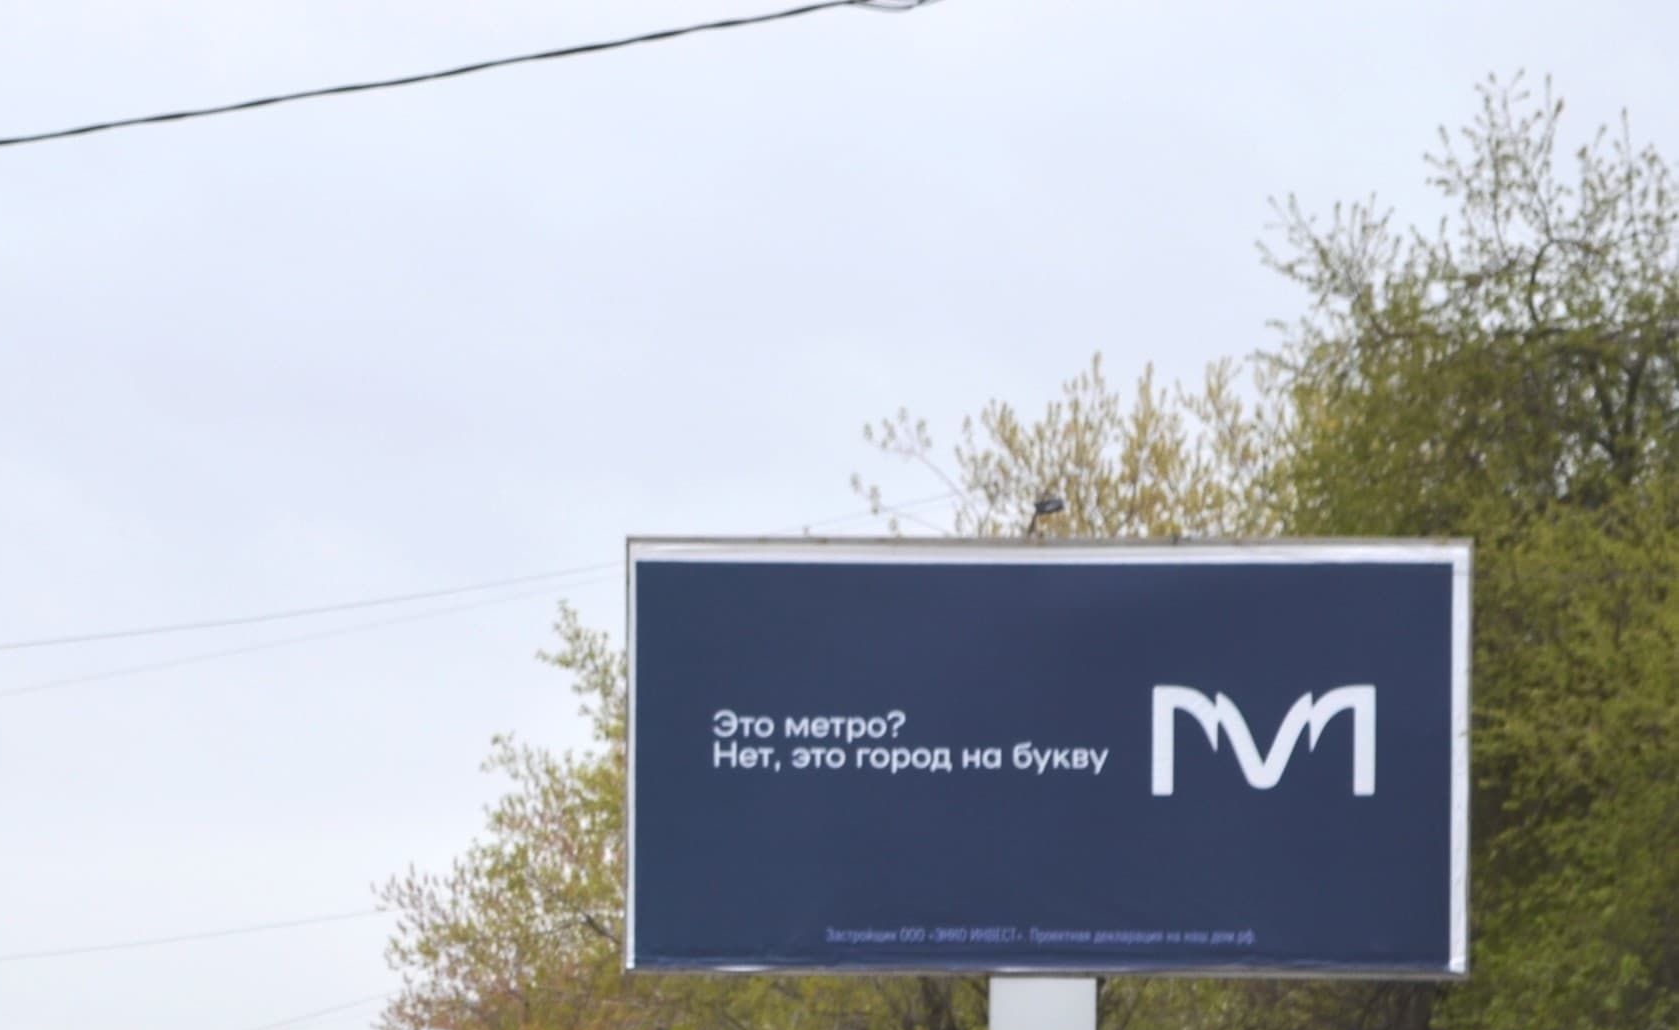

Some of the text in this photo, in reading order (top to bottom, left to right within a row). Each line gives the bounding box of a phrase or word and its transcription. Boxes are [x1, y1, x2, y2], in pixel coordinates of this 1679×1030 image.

[712, 709, 907, 744] Это метро?
[712, 740, 1110, 775] Нет, это город на букву
